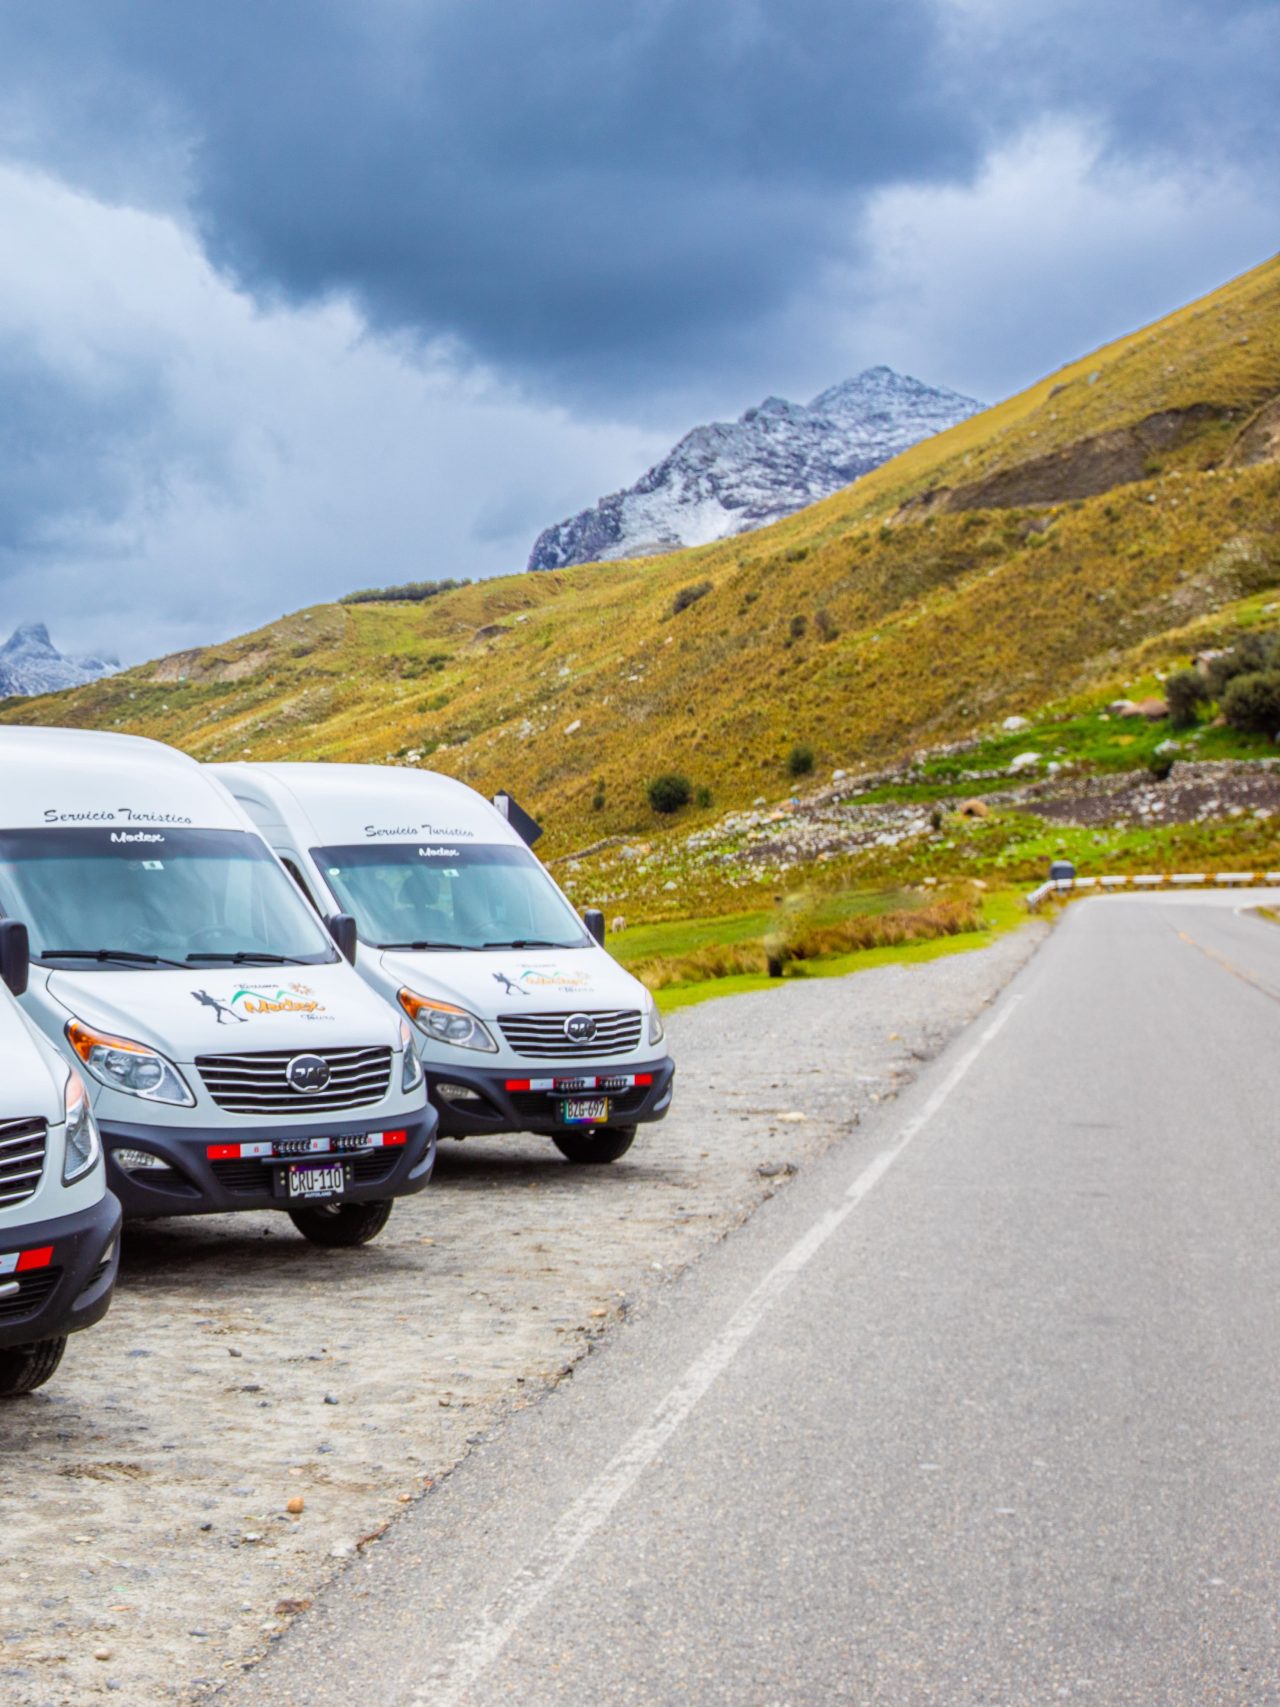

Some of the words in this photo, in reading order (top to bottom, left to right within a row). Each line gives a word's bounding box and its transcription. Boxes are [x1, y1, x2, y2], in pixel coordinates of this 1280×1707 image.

[44, 809, 116, 823] Servicio
[117, 808, 193, 825] Turistico
[110, 831, 166, 844] Modex
[364, 825, 419, 838] Servicio
[290, 1167, 342, 1192] CRU-110
